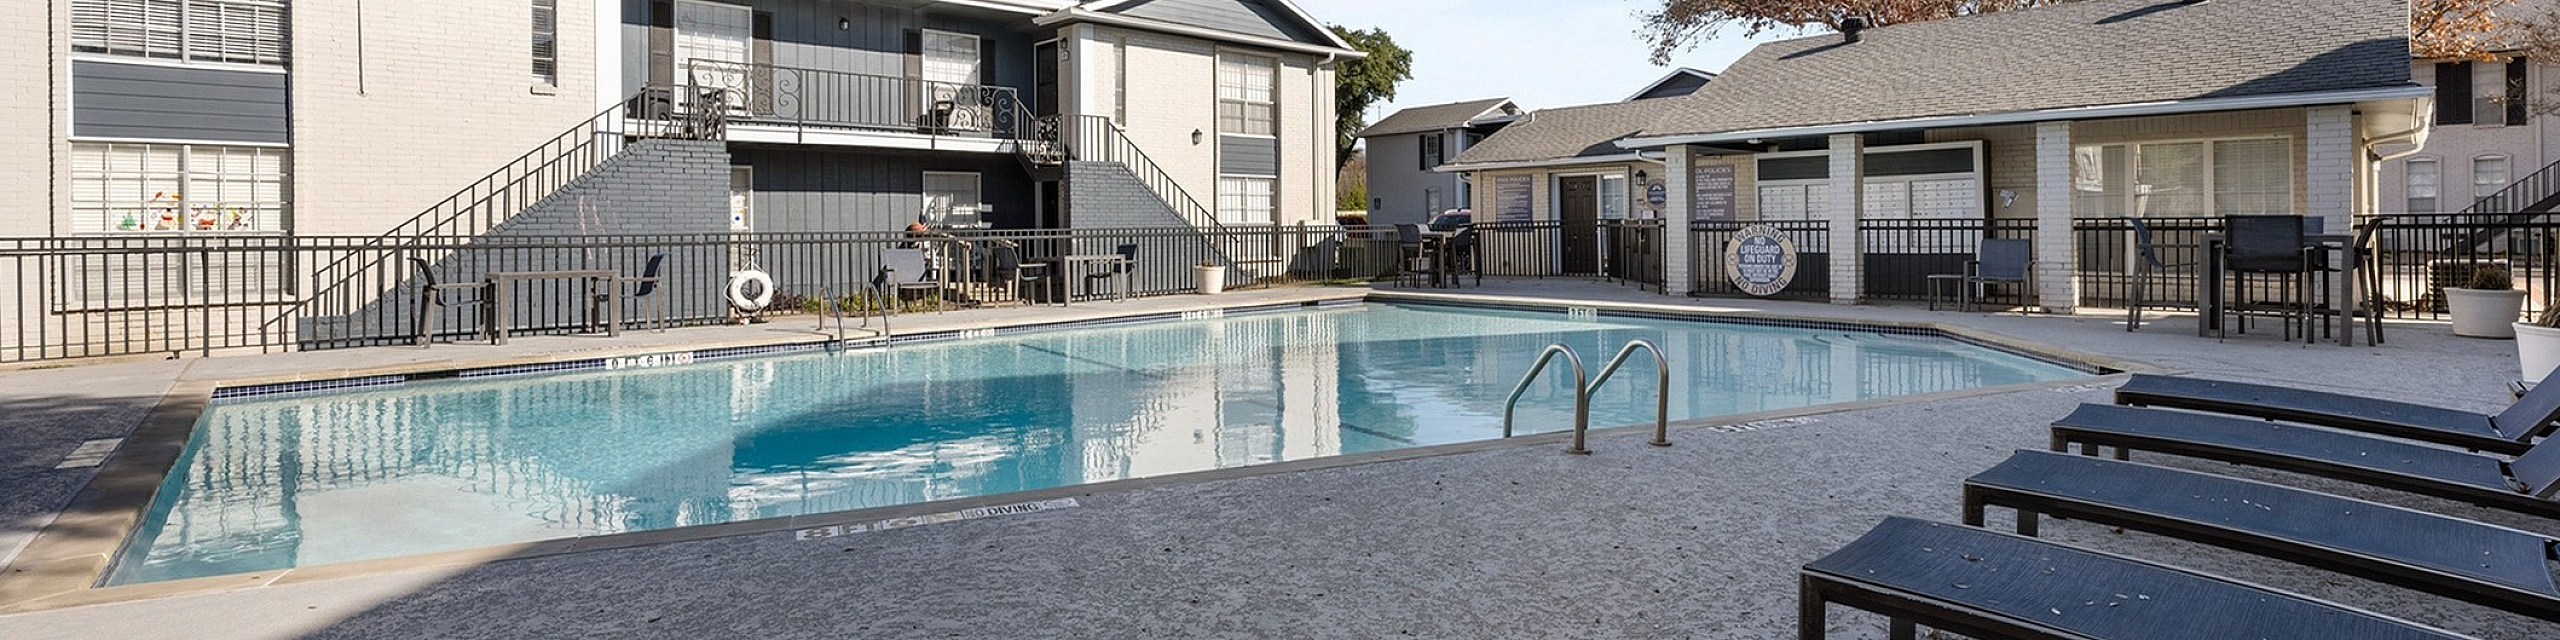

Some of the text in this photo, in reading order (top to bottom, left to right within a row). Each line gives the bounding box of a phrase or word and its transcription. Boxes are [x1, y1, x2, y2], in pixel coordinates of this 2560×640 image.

[1734, 225, 1785, 243] WARNING
[1754, 236, 1766, 245] NO
[1740, 245, 1780, 254] LIFEGUARD
[1744, 254, 1776, 264] ON DUTY
[1734, 276, 1787, 294] NO DIVING
[987, 502, 1039, 515] DIVING
